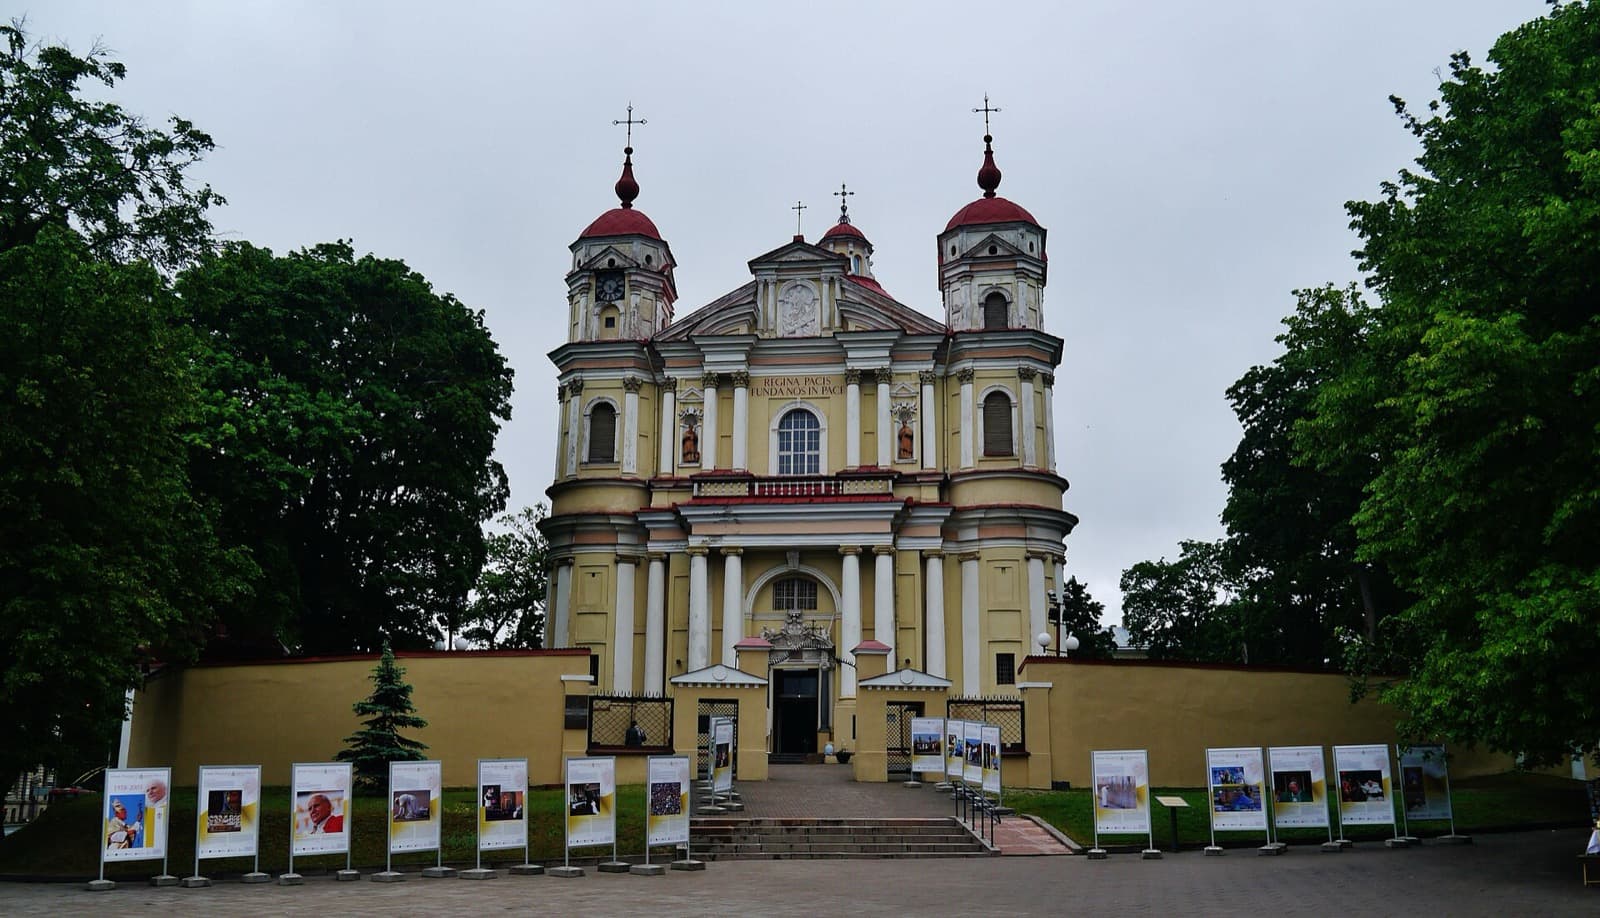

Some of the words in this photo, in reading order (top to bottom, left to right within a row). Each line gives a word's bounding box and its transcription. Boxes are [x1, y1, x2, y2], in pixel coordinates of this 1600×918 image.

[764, 377, 800, 387] REGINA
[804, 376, 831, 386] PACIS
[787, 386, 806, 396] NOS
[808, 386, 819, 396] IN
